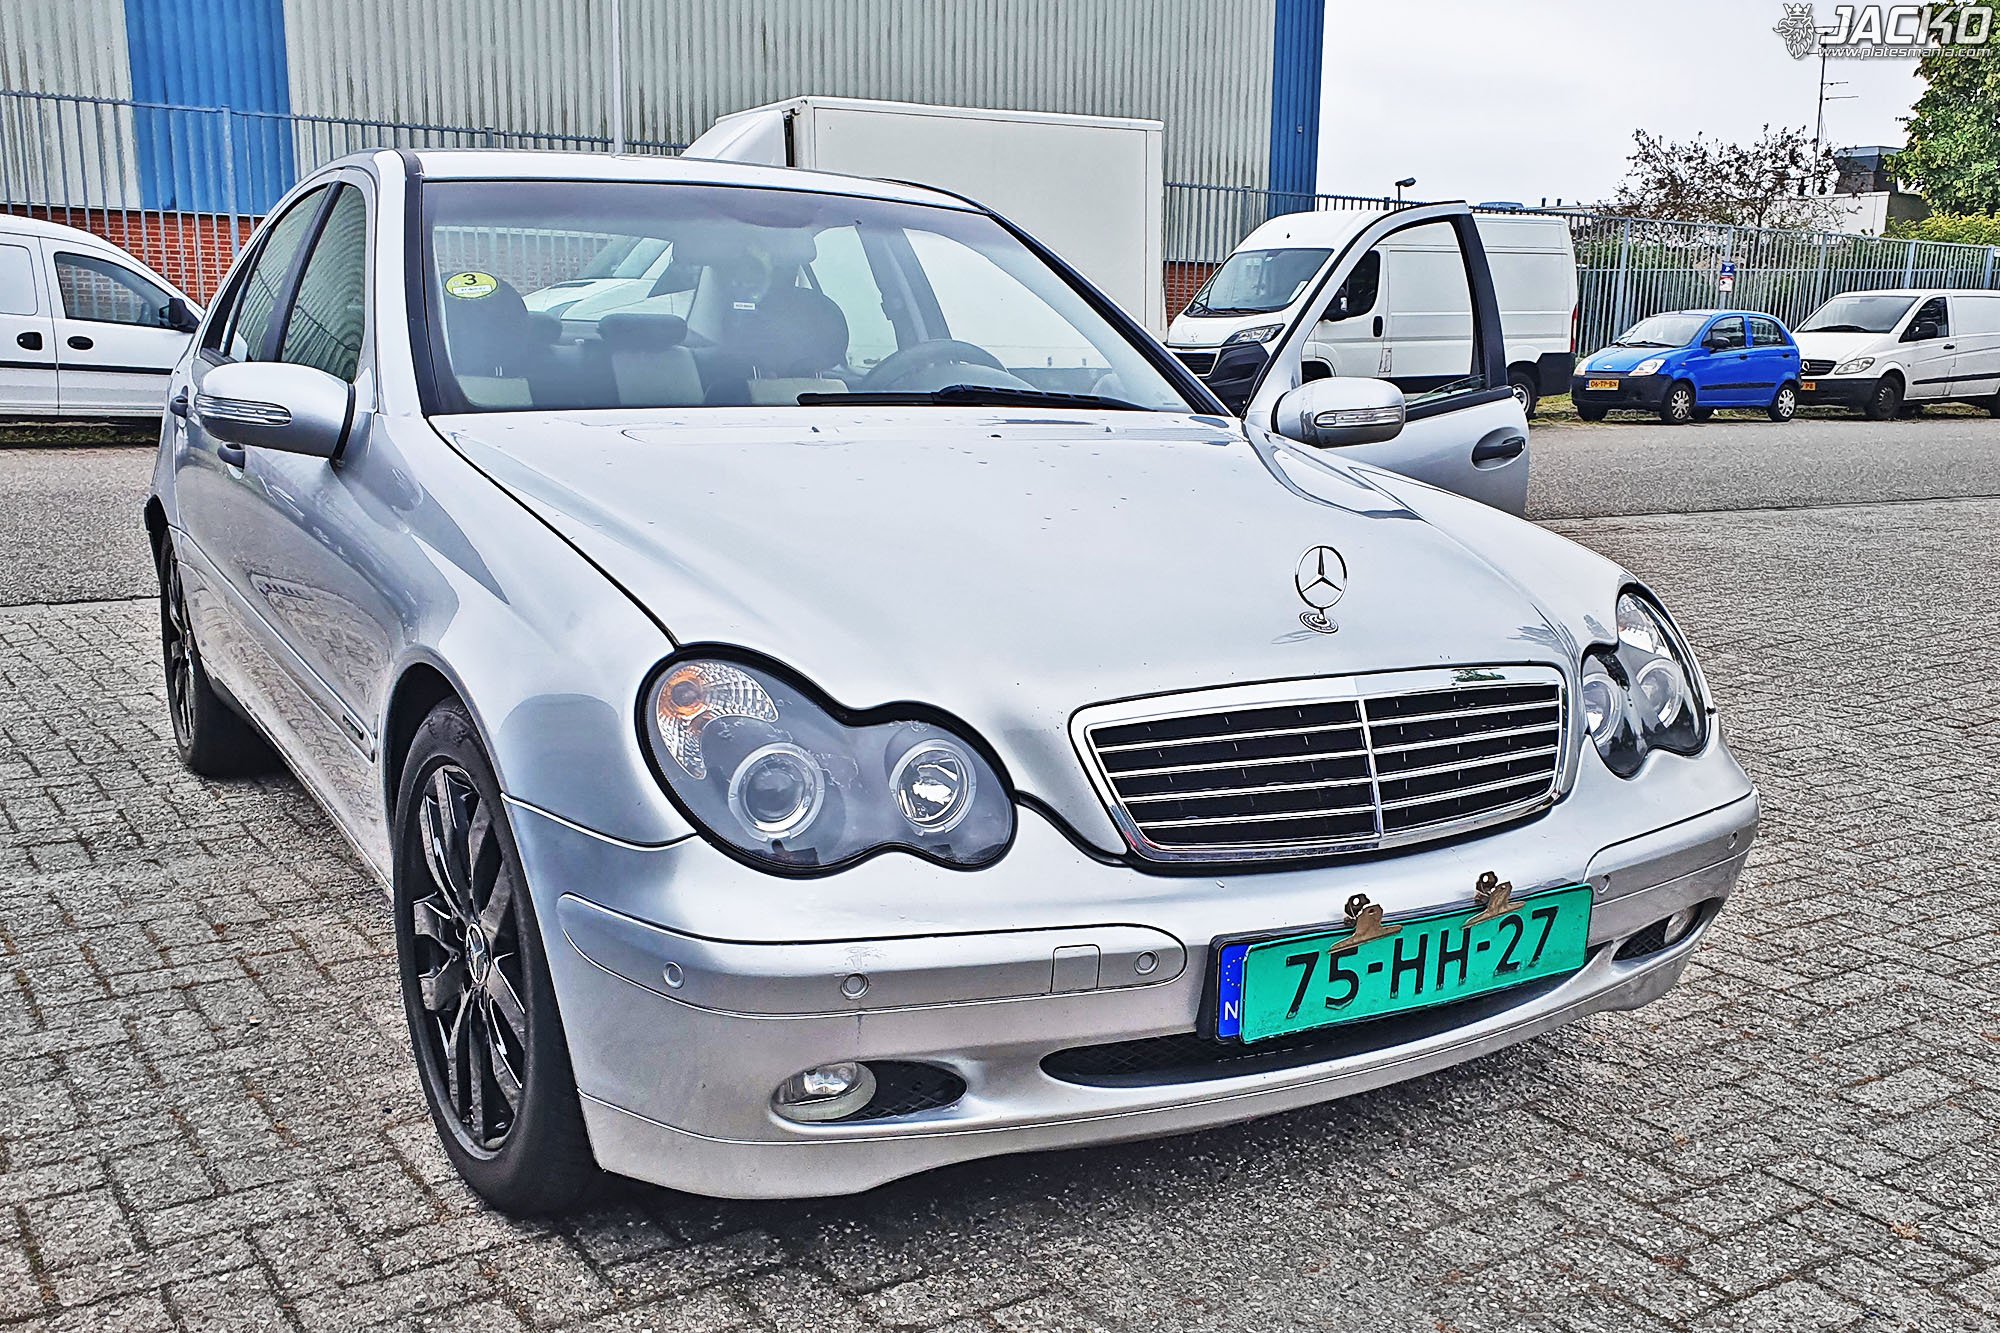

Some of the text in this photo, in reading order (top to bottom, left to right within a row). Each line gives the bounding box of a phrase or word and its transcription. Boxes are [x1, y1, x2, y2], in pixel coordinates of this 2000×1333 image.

[463, 274, 477, 285] 3
[1285, 906, 1559, 1018] 75-HH-27
[1224, 1000, 1238, 1020] N
